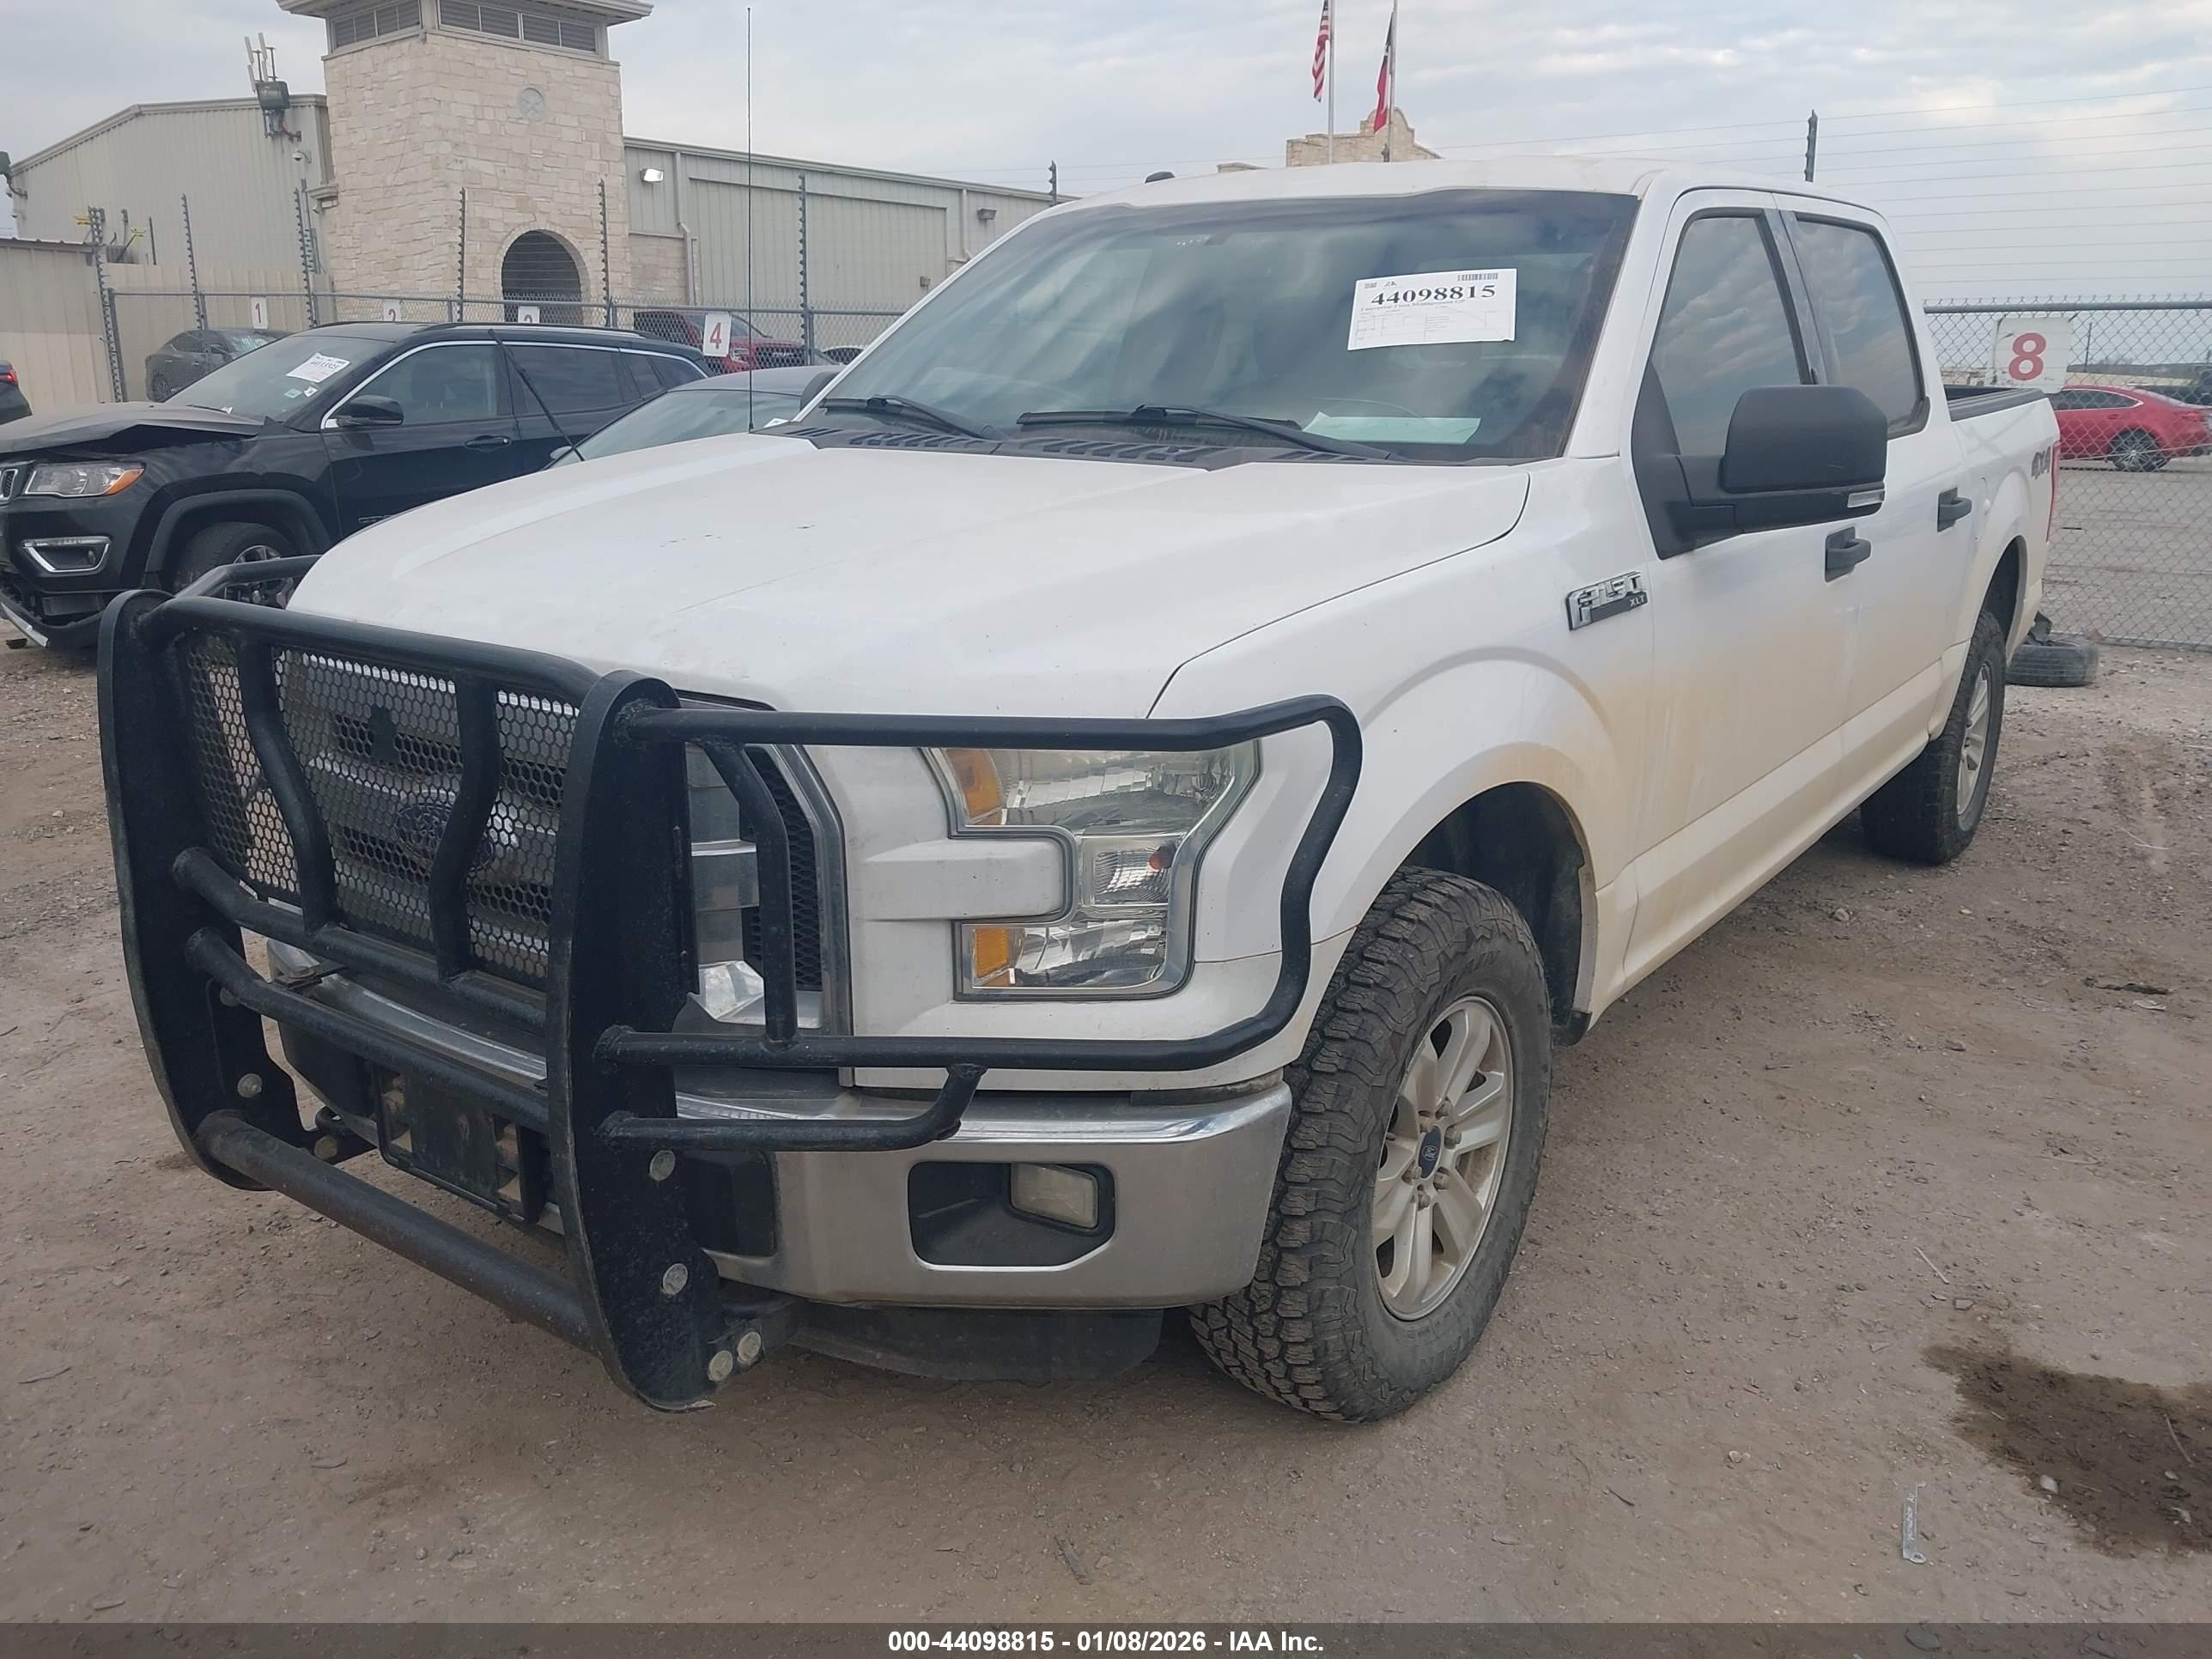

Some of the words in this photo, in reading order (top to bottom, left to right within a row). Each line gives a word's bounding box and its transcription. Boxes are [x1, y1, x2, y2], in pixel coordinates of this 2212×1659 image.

[1371, 284, 1496, 306] 44098815
[255, 302, 262, 324] 1
[709, 321, 722, 349] 4
[2008, 331, 2047, 380] 8
[1629, 594, 1646, 608] XLT
